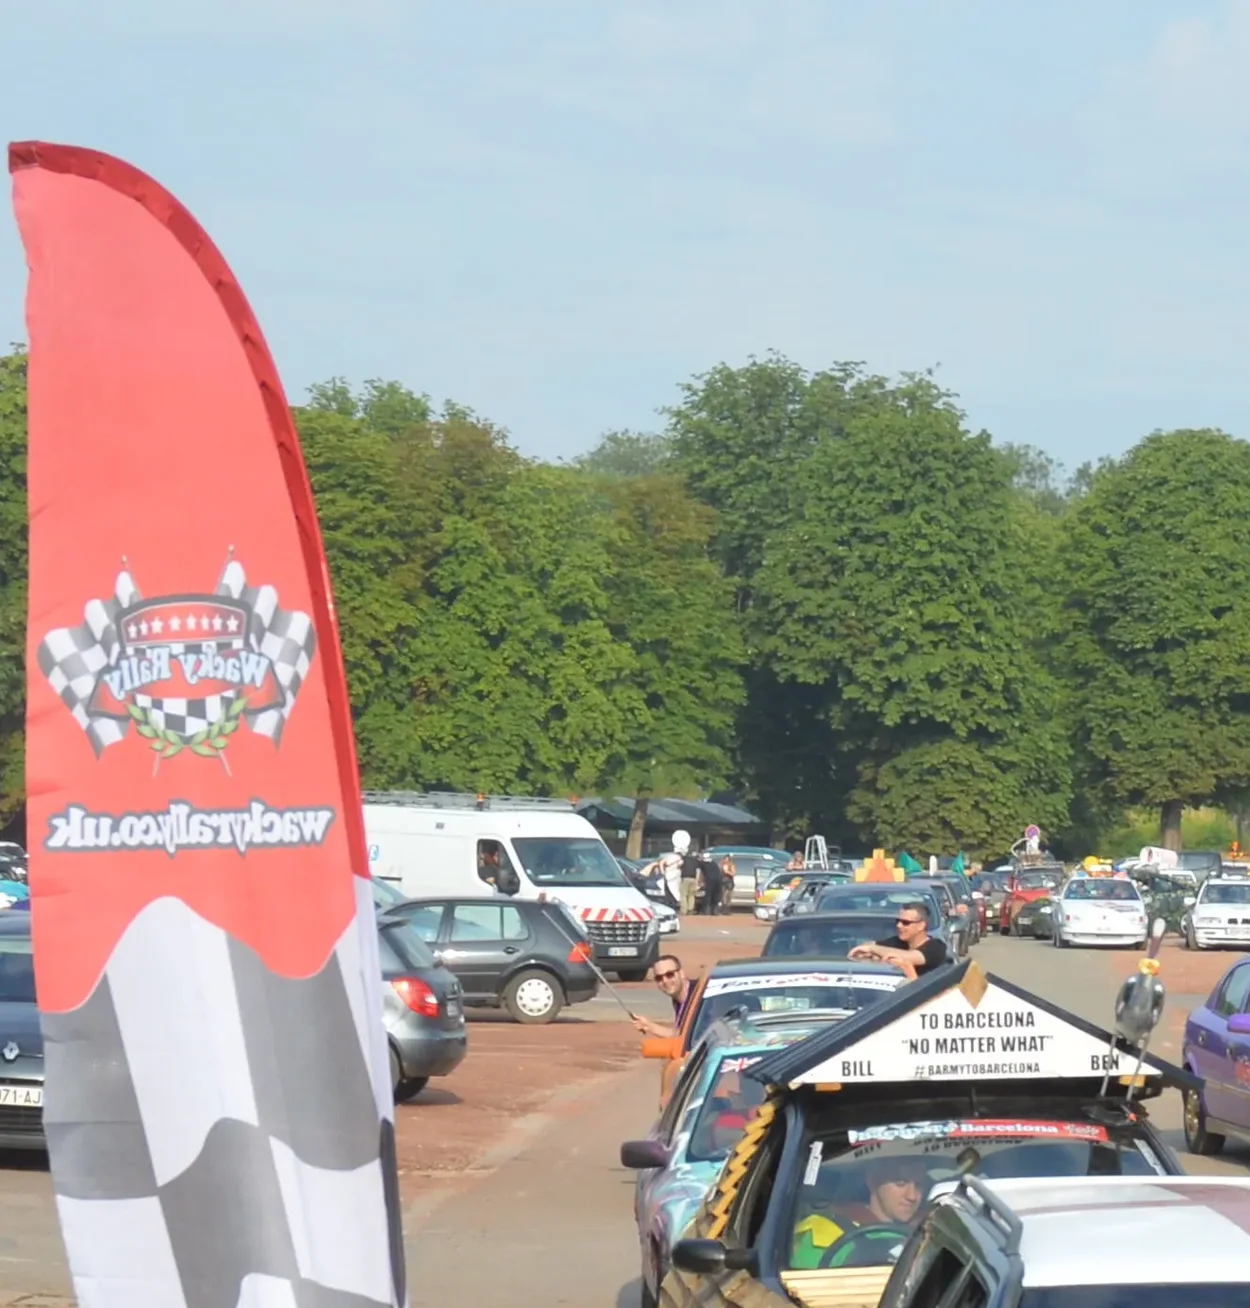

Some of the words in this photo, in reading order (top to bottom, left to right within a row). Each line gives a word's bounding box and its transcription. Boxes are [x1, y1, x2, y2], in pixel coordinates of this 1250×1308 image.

[919, 1013, 939, 1030] TO
[944, 1011, 1036, 1029] BARCELONA
[935, 1036, 997, 1054] MATTER
[841, 1060, 875, 1077] BILL
[1090, 1054, 1120, 1072] BEN
[961, 1123, 1059, 1134] Barcelona
